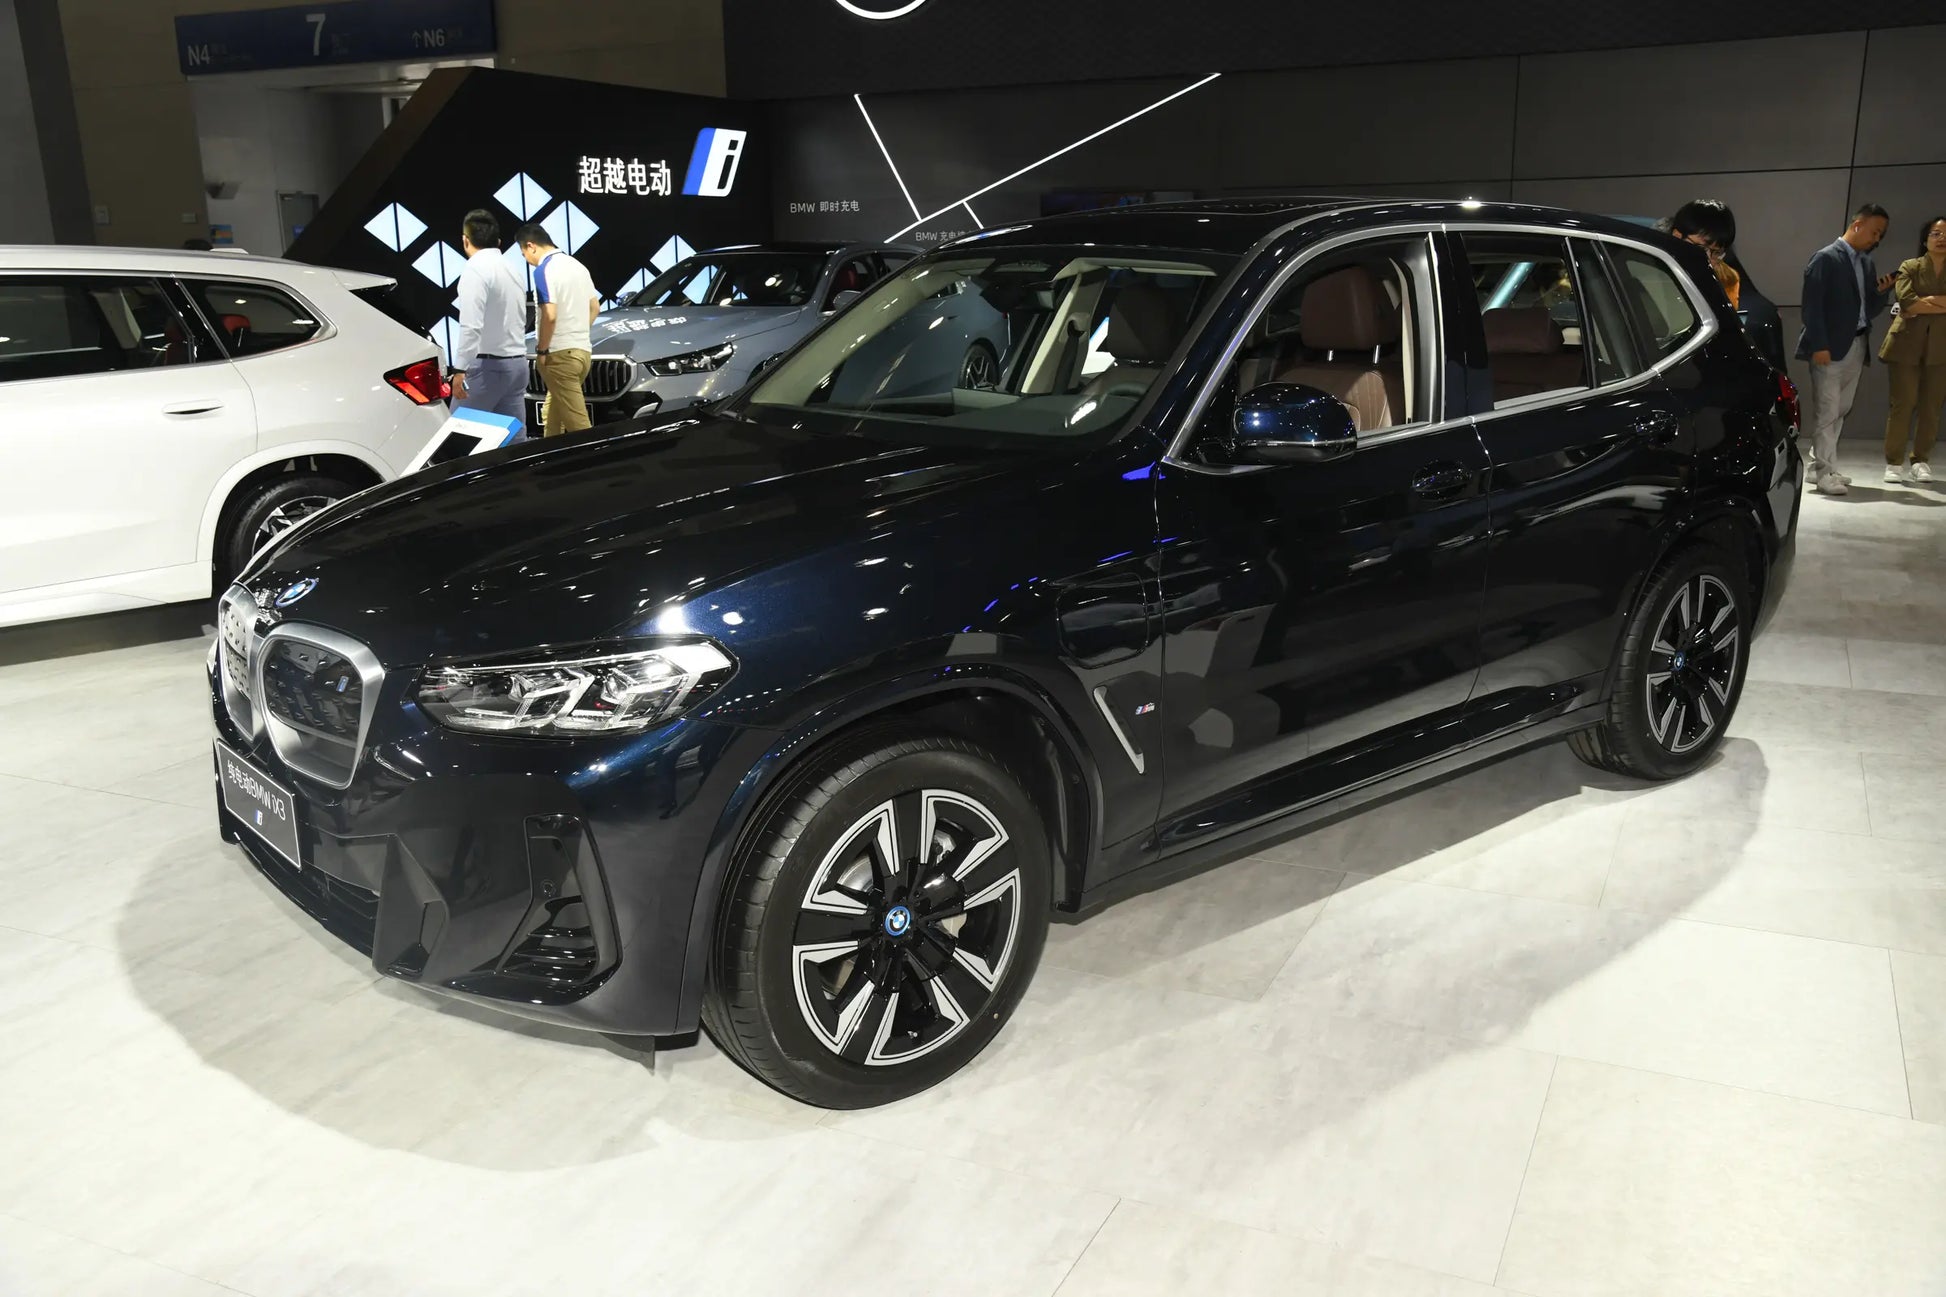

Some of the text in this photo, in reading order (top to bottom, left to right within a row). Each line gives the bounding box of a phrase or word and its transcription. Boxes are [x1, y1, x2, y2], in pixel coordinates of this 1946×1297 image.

[306, 13, 326, 56] 7
[423, 28, 445, 48] N6
[187, 44, 210, 66] N4
[578, 155, 672, 196] 超越电动
[790, 200, 860, 213] BMW 即时充电
[915, 231, 938, 242] BMW
